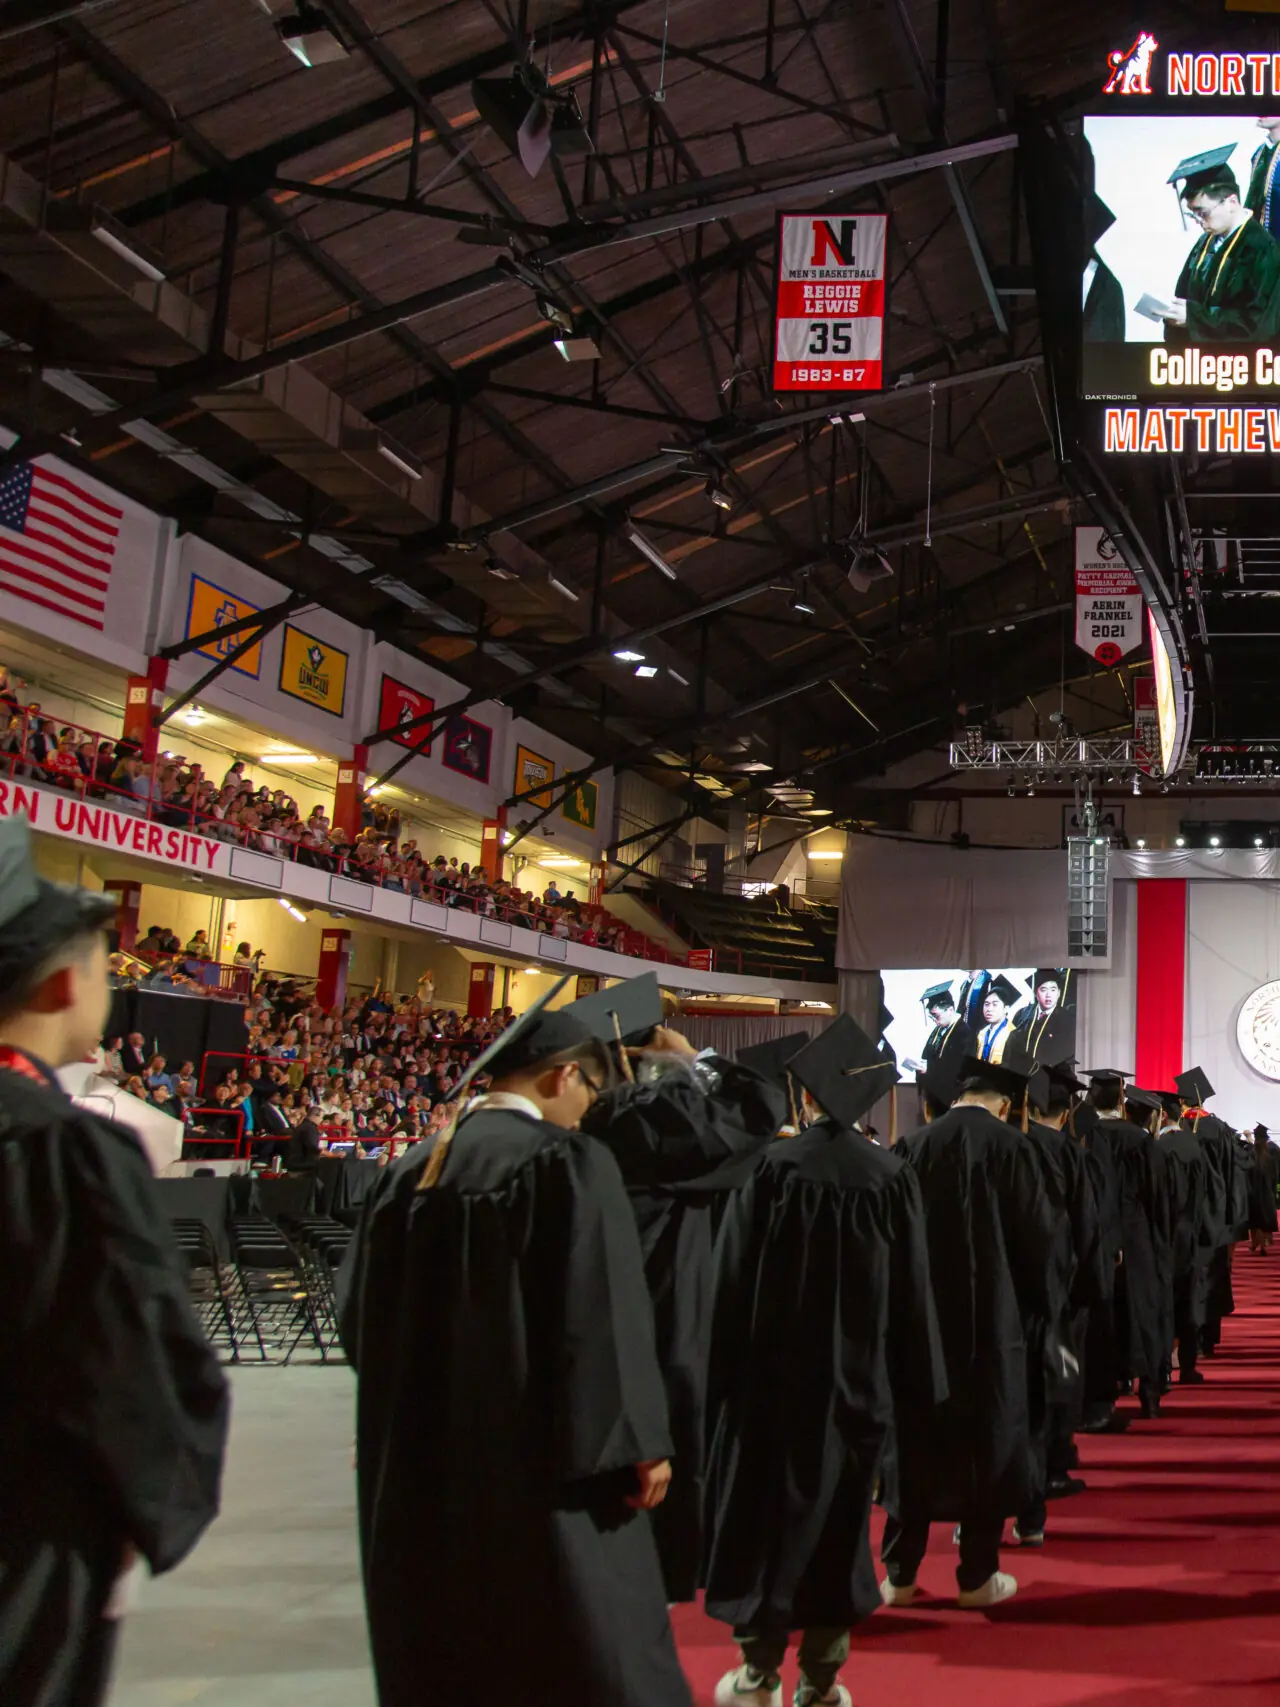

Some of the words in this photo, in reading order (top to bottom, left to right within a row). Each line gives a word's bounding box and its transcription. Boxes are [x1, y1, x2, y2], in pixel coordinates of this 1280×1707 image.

[811, 220, 856, 266] N
[789, 270, 817, 278] MEN'S
[819, 269, 877, 278] BASKETBALL
[803, 285, 861, 298] REGGIE
[805, 300, 859, 313] LEWIS
[809, 323, 852, 354] 35
[1150, 348, 1249, 391] College
[1092, 601, 1125, 610] AERIN
[1084, 611, 1133, 621] FRANKEL
[1092, 625, 1125, 638] 2021
[55, 797, 222, 870] UNIVERSITY
